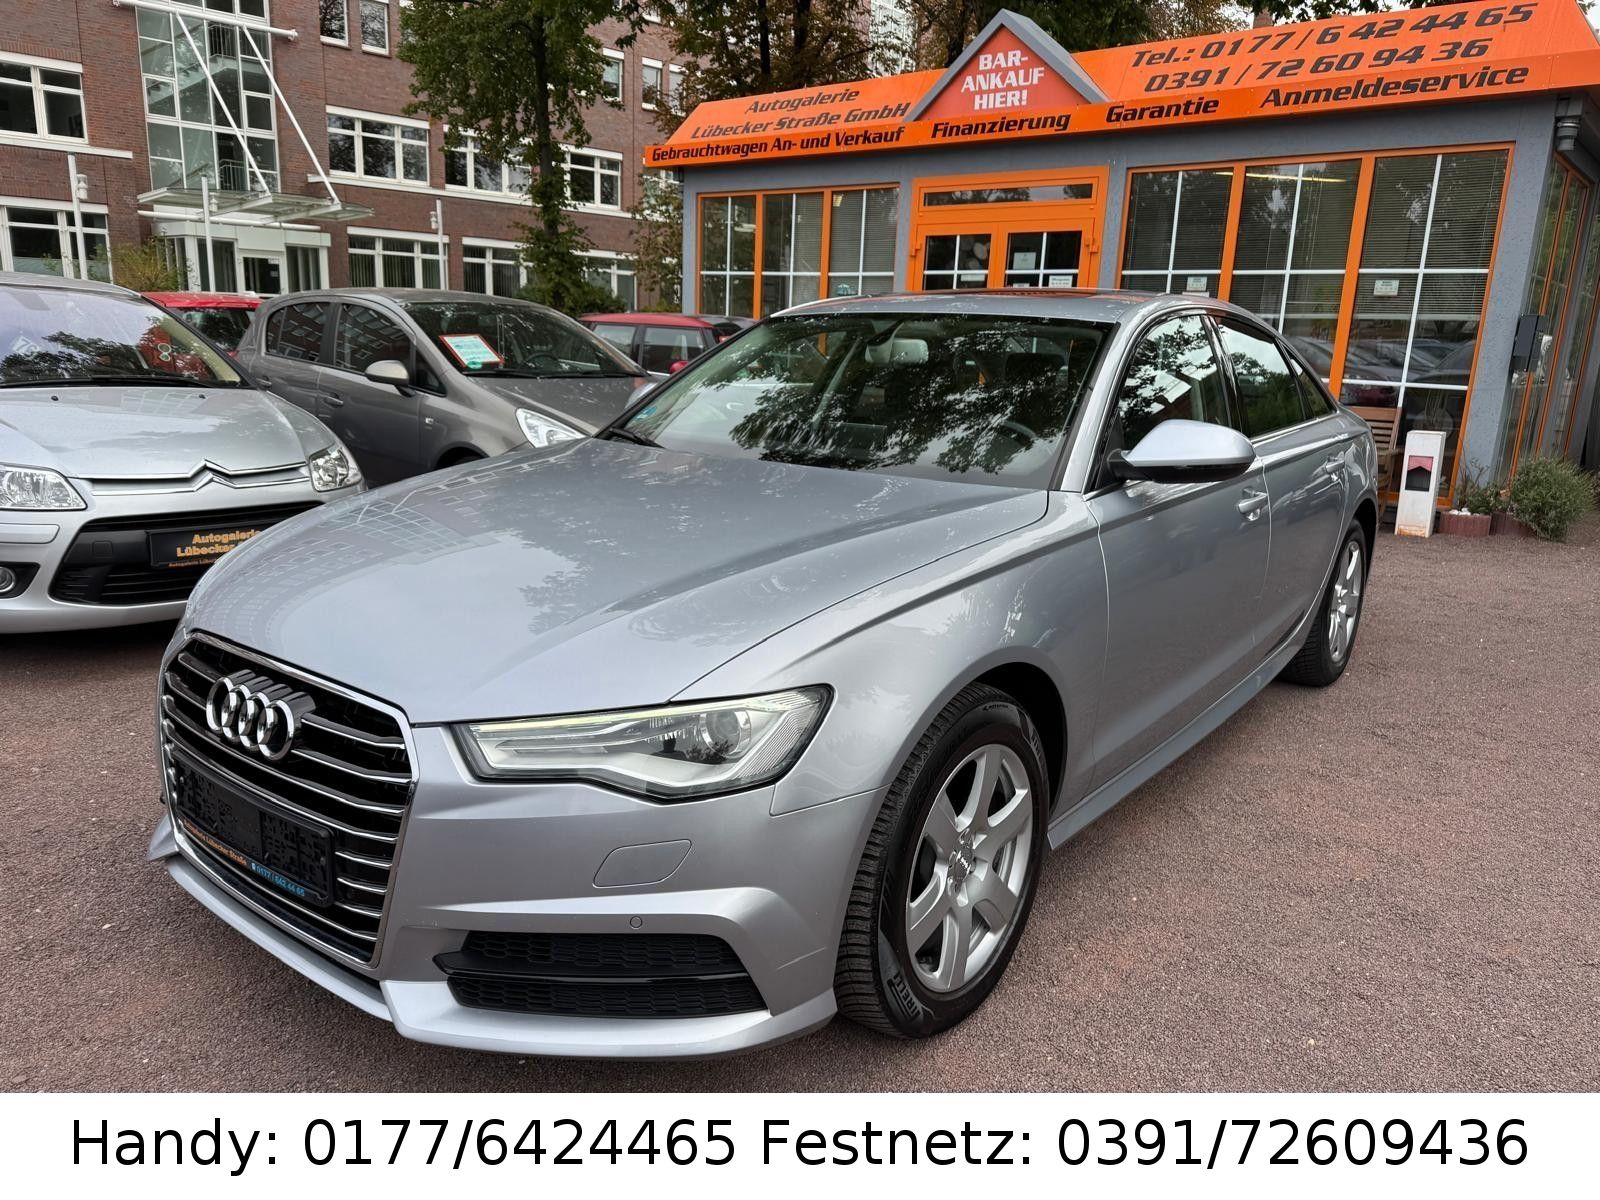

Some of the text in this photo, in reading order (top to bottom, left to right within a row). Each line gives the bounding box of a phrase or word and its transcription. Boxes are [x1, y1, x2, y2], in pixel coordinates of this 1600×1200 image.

[1132, 47, 1195, 67] Tel.:
[1200, 32, 1296, 58] 0177
[1348, 19, 1405, 40] 42
[1409, 11, 1469, 33] 44
[1474, 3, 1538, 27] 65
[979, 50, 1029, 71] BAR-
[1144, 66, 1230, 92] 0391
[1256, 58, 1305, 81] 72
[1310, 52, 1364, 74] 60
[1368, 45, 1426, 68] 94
[1431, 38, 1493, 62] 36
[961, 67, 1045, 93] ANKAUF
[1259, 66, 1530, 109] Anmeldeservice
[744, 88, 860, 115] Autogalerie
[974, 89, 1028, 111] HIER!
[1106, 96, 1219, 123] Garantie
[691, 102, 911, 139] Lübecker Straße GmbH
[931, 113, 1071, 139] Finanzierung
[652, 126, 906, 162] Gebrauchtwagen An- und Verkauf
